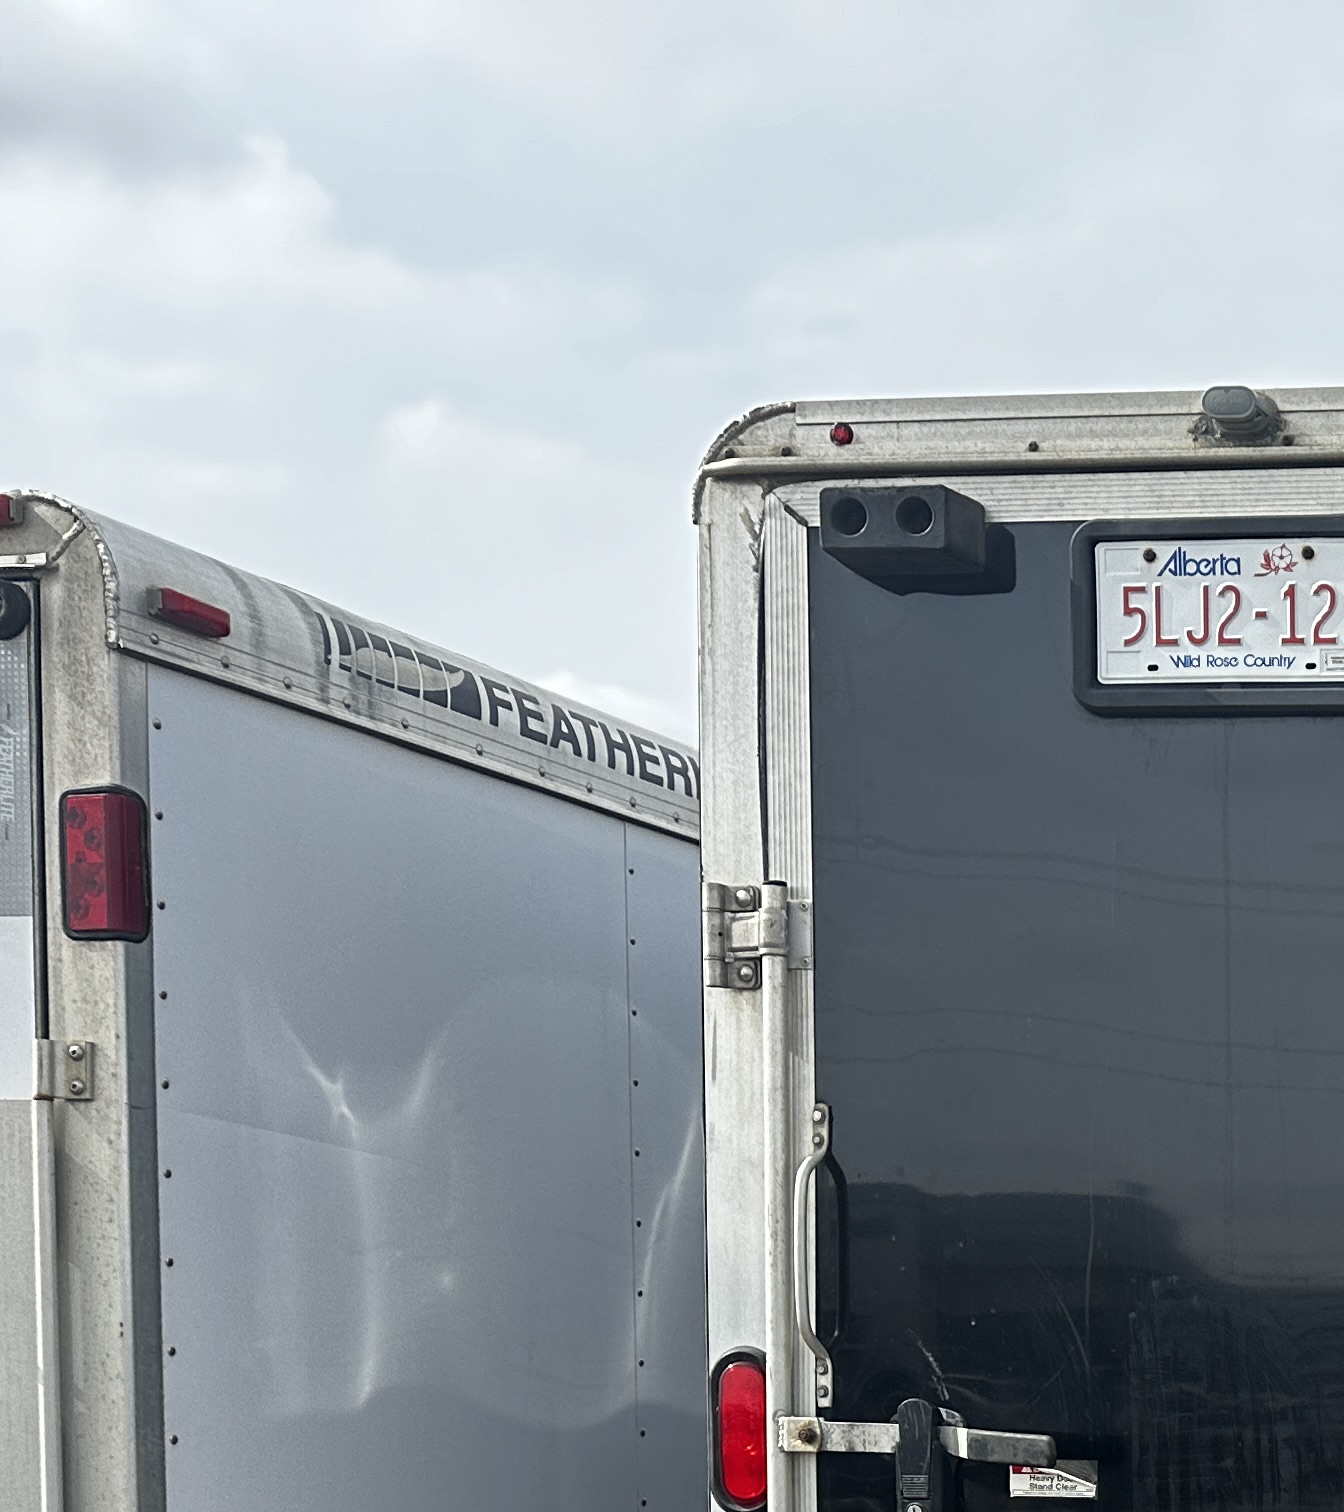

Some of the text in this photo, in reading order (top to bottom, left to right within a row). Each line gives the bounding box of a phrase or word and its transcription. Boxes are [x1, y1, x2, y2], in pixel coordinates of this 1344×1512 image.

[1157, 546, 1241, 577] Alberta
[1122, 583, 1338, 647] 5LJ2-12
[1169, 654, 1296, 669] Wild Rose Country
[1029, 1483, 1053, 1491] Stand
